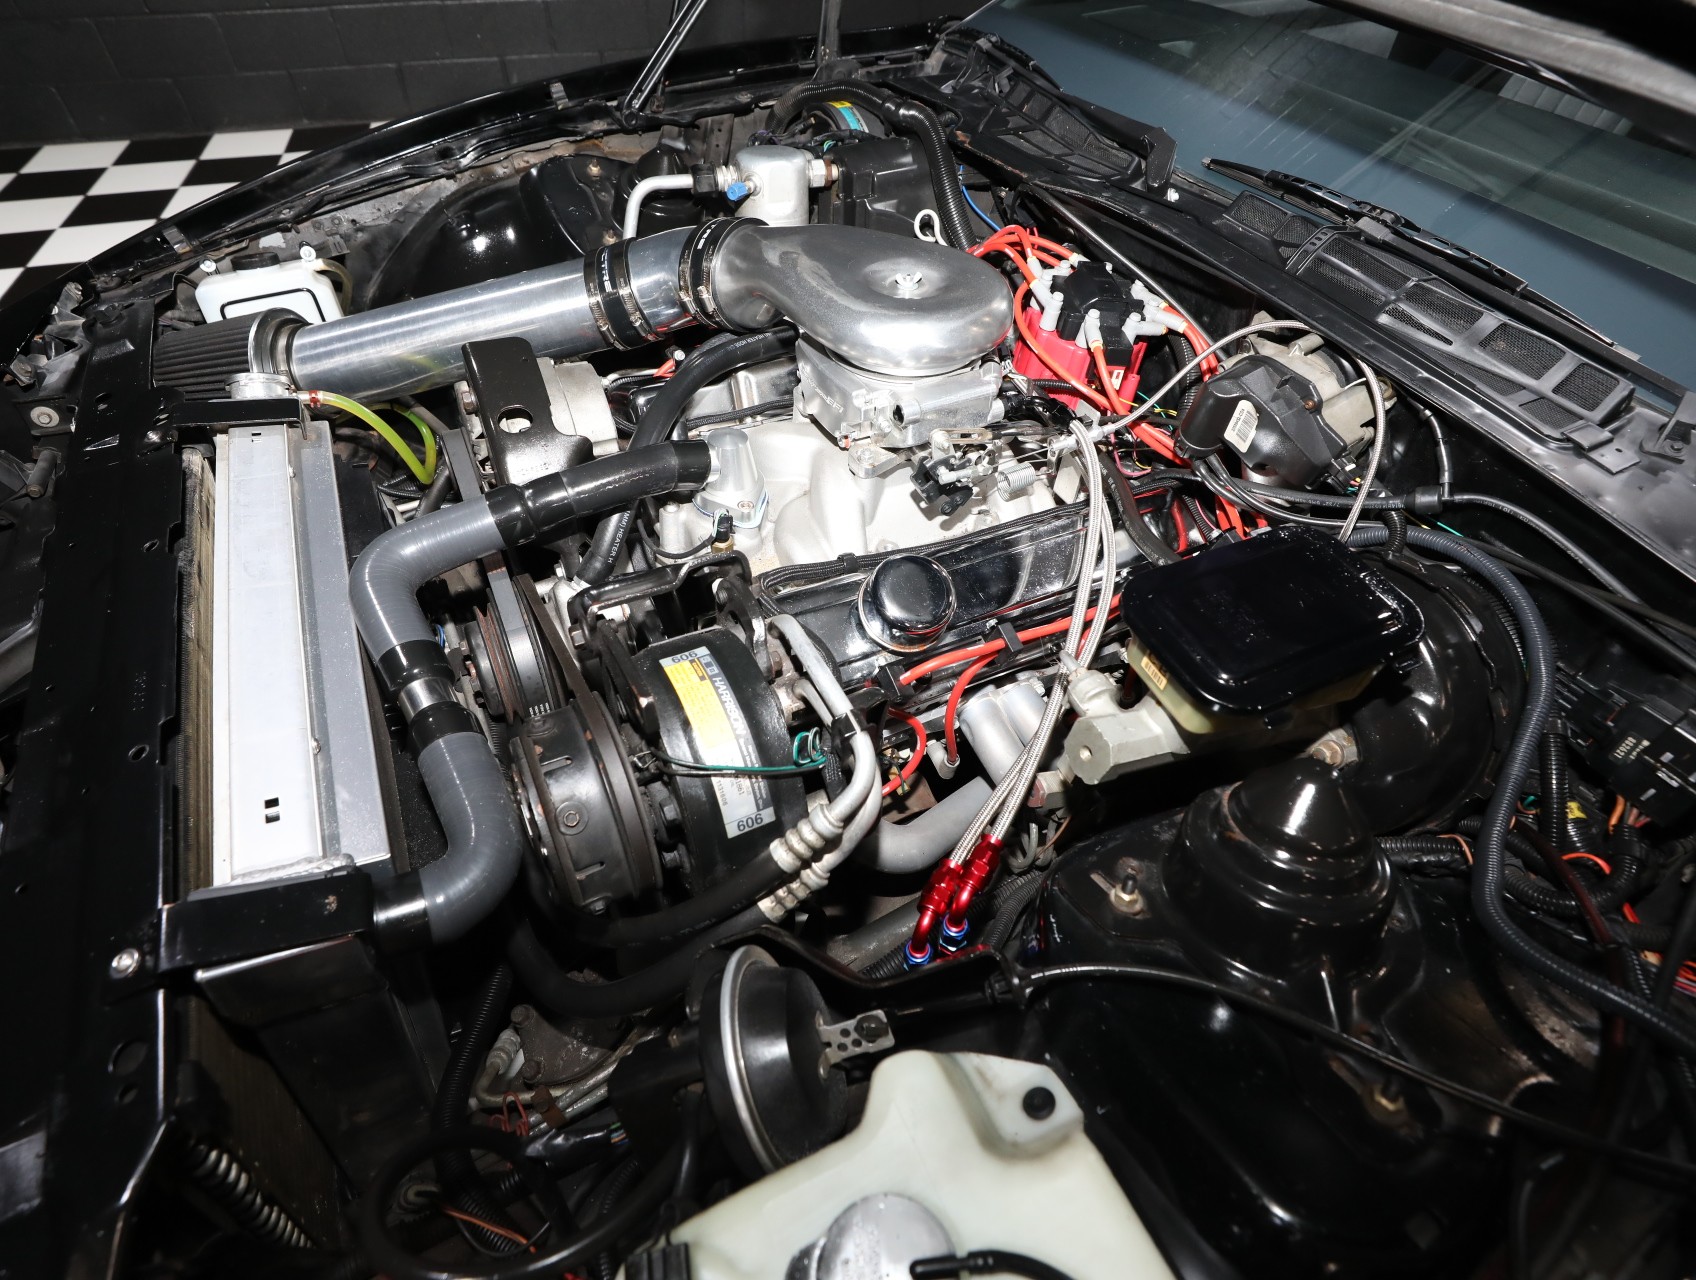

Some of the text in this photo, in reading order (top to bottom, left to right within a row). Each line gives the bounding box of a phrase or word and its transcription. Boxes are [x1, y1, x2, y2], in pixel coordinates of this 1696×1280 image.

[610, 528, 624, 557] HEATER
[671, 650, 698, 664] 606
[712, 677, 748, 735] HARRISON
[736, 812, 765, 833] 606
